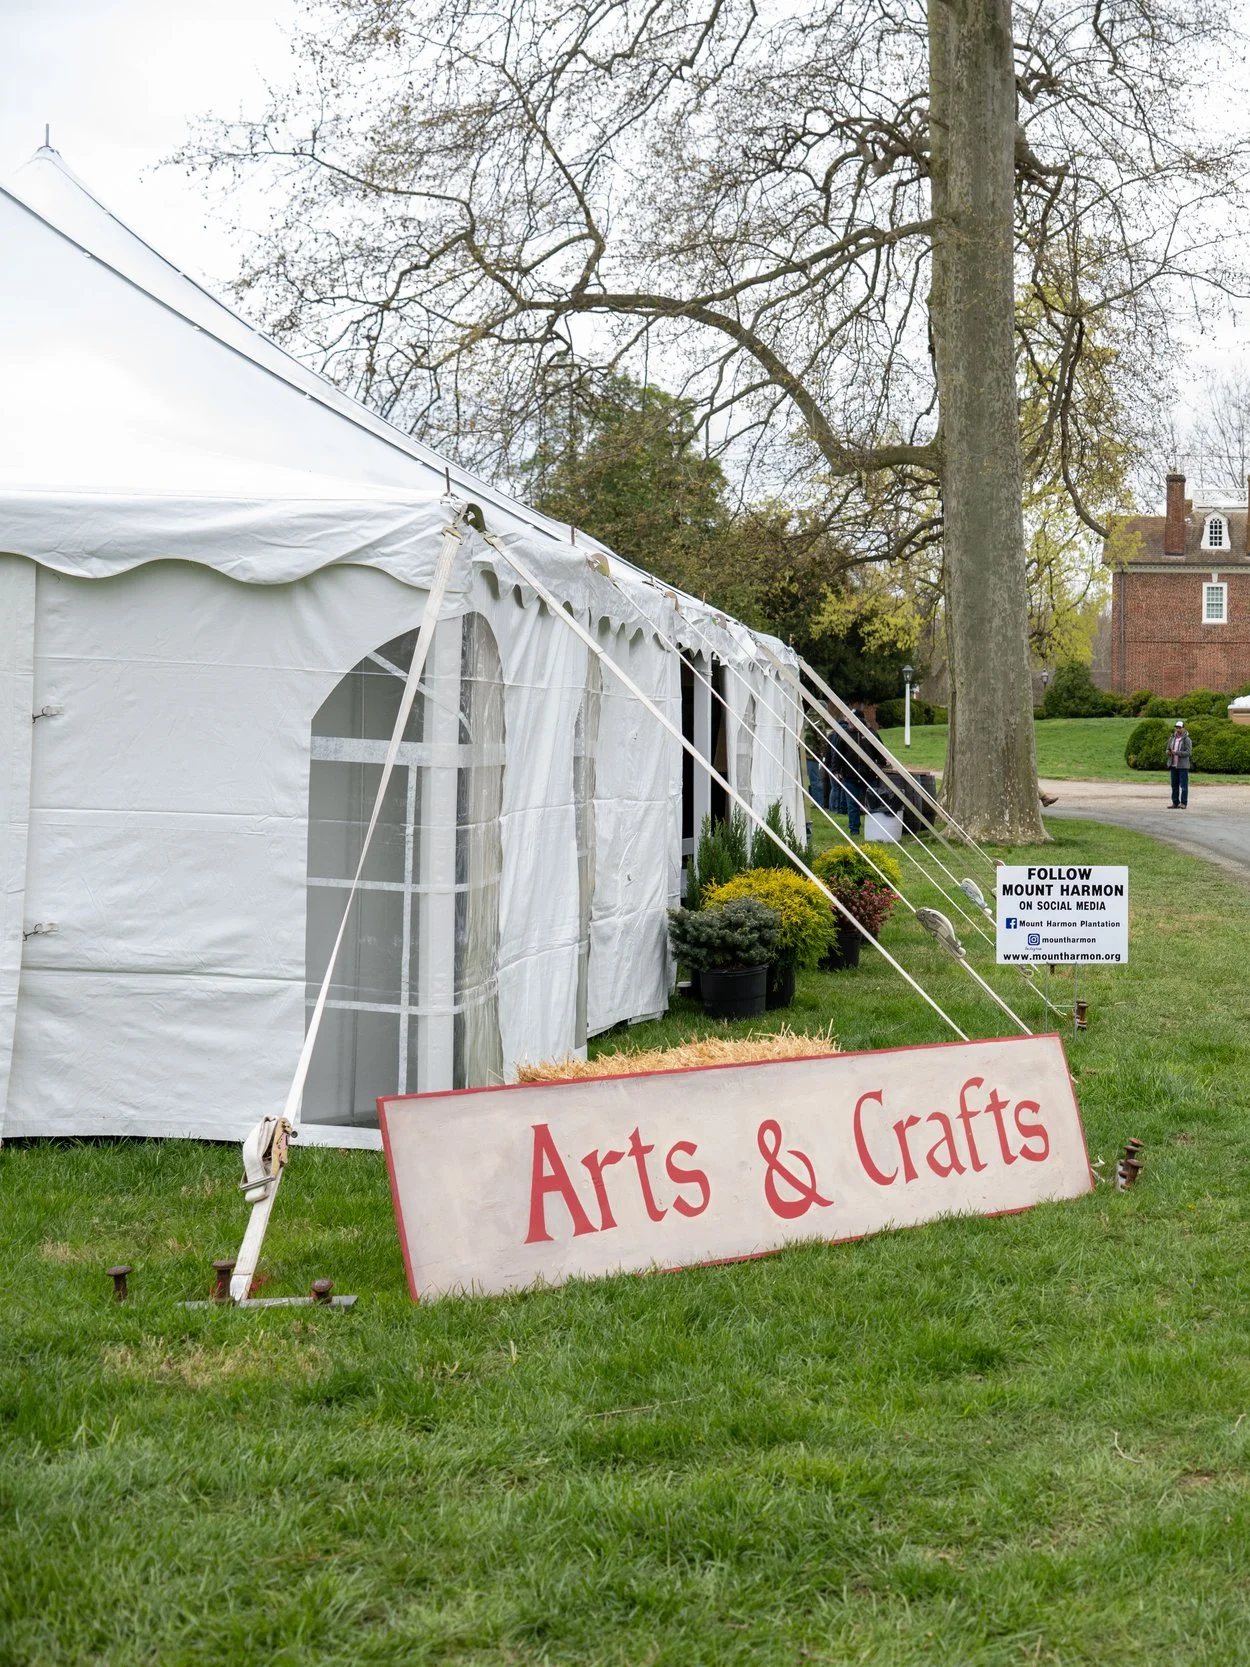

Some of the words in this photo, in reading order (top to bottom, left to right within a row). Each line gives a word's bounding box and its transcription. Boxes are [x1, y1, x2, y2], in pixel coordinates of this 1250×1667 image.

[1028, 868, 1092, 880] FOLLOW
[1003, 884, 1053, 896] MOUNT
[1061, 885, 1123, 896] HARMON
[1019, 901, 1032, 910] ON
[1037, 901, 1072, 910] SOCIAL
[1076, 901, 1106, 910] MEDIA
[1003, 952, 1121, 962] www.mountharmon.org
[526, 1124, 710, 1243] Arts
[758, 1120, 832, 1219] &
[854, 1077, 1049, 1185] Crafts
